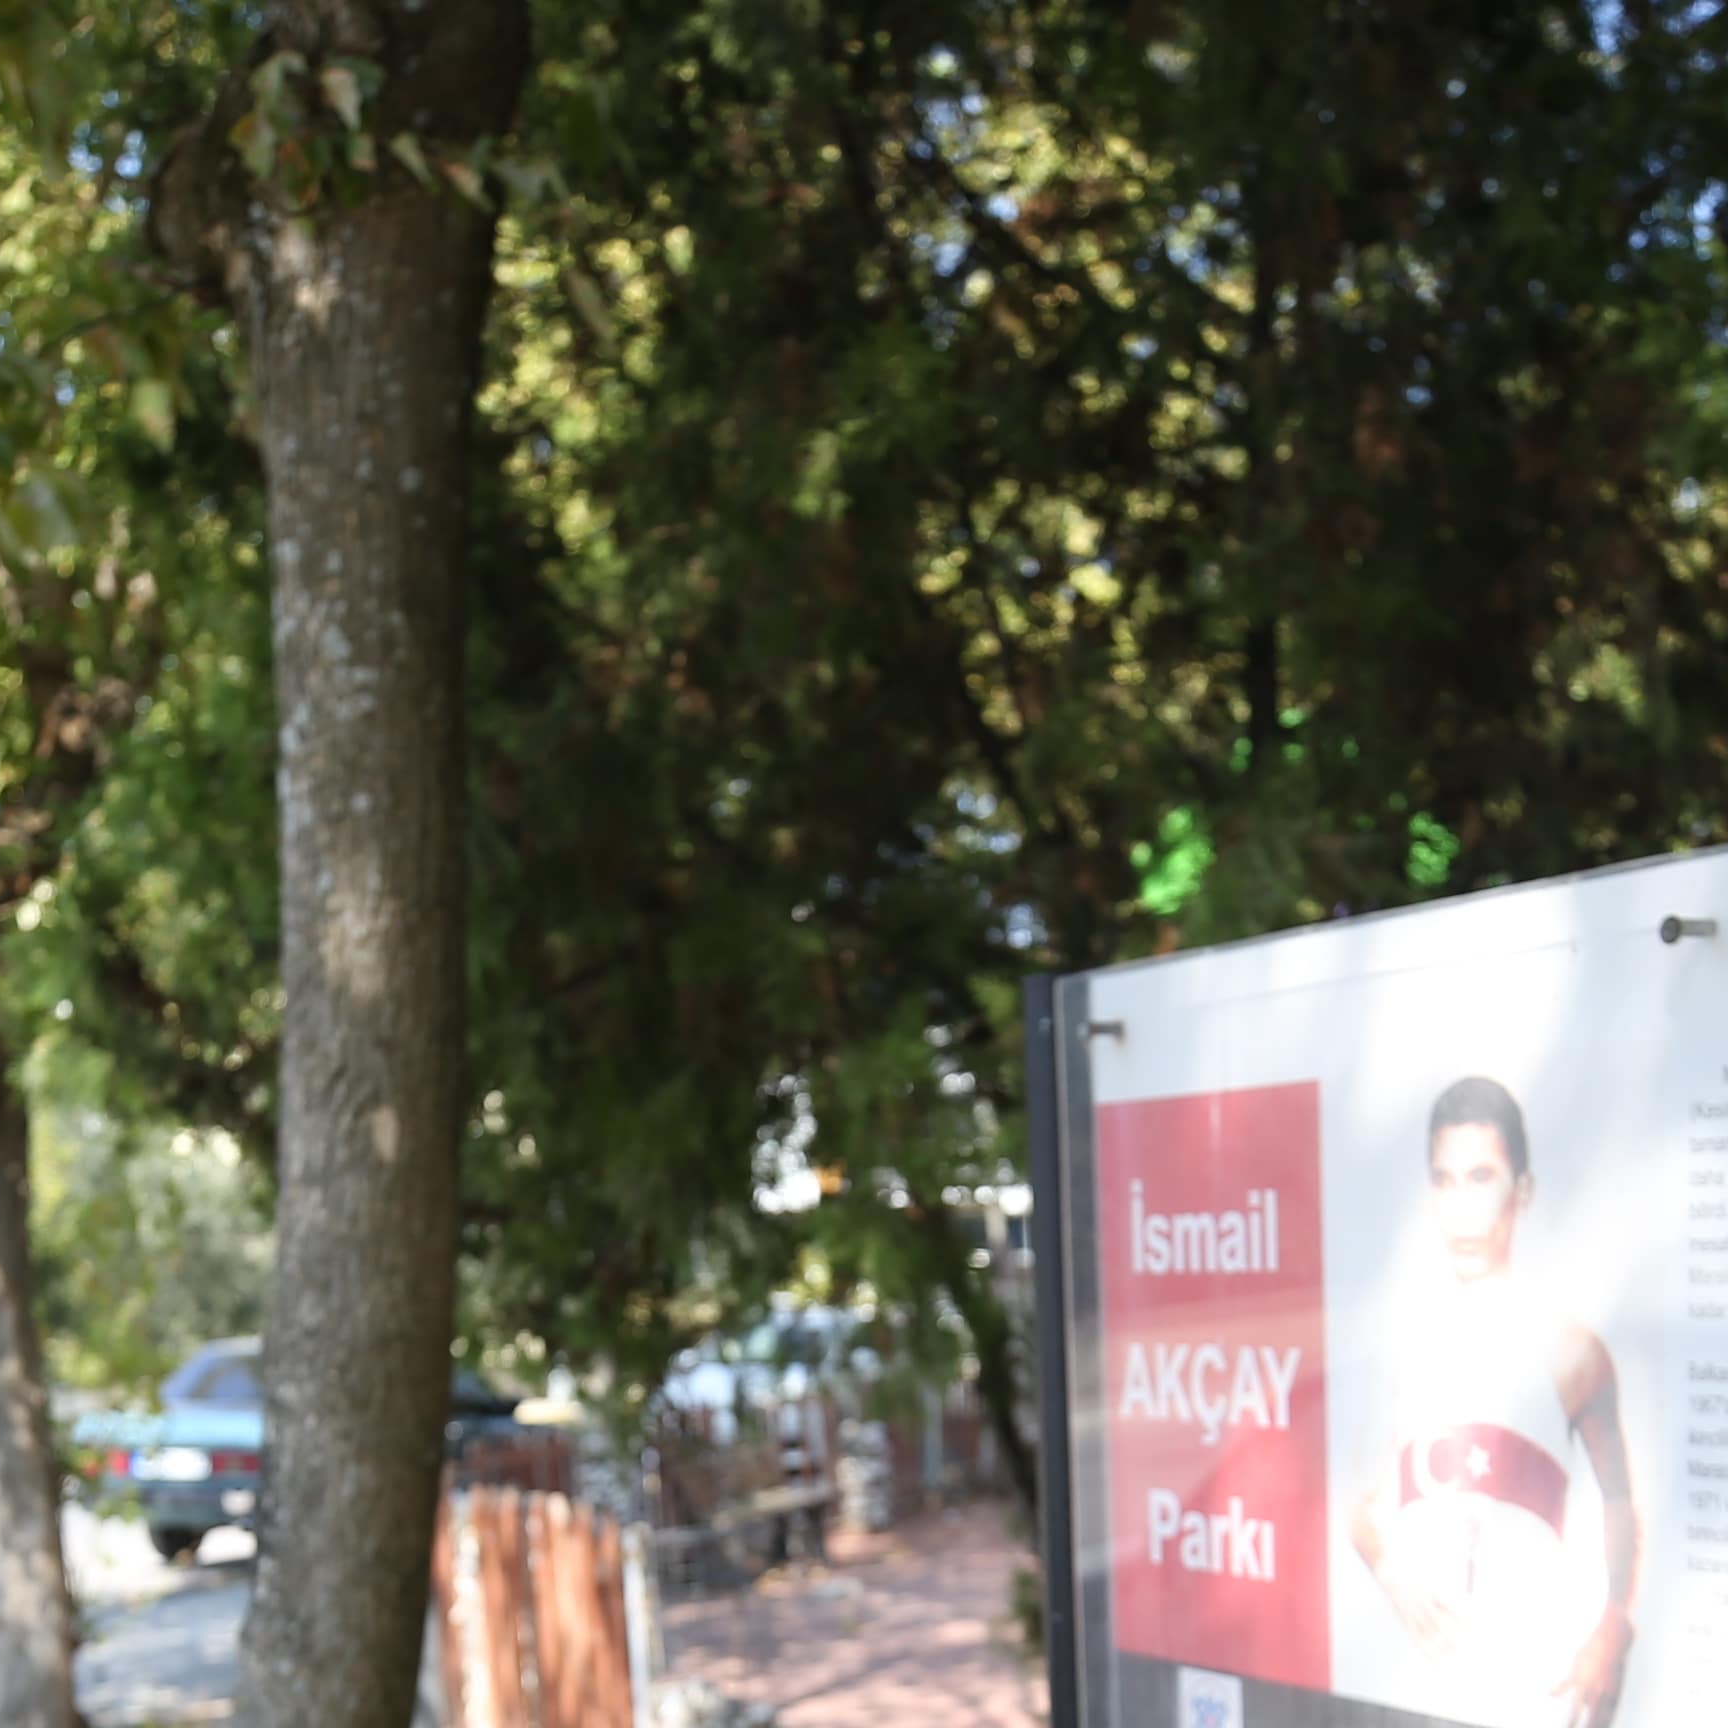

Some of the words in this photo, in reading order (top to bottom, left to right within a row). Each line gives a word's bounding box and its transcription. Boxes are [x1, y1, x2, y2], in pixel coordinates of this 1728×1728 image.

[1130, 1179, 1278, 1275] İsmail
[1118, 1342, 1302, 1445] AKÇAY
[1147, 1488, 1274, 1582] Parkı
